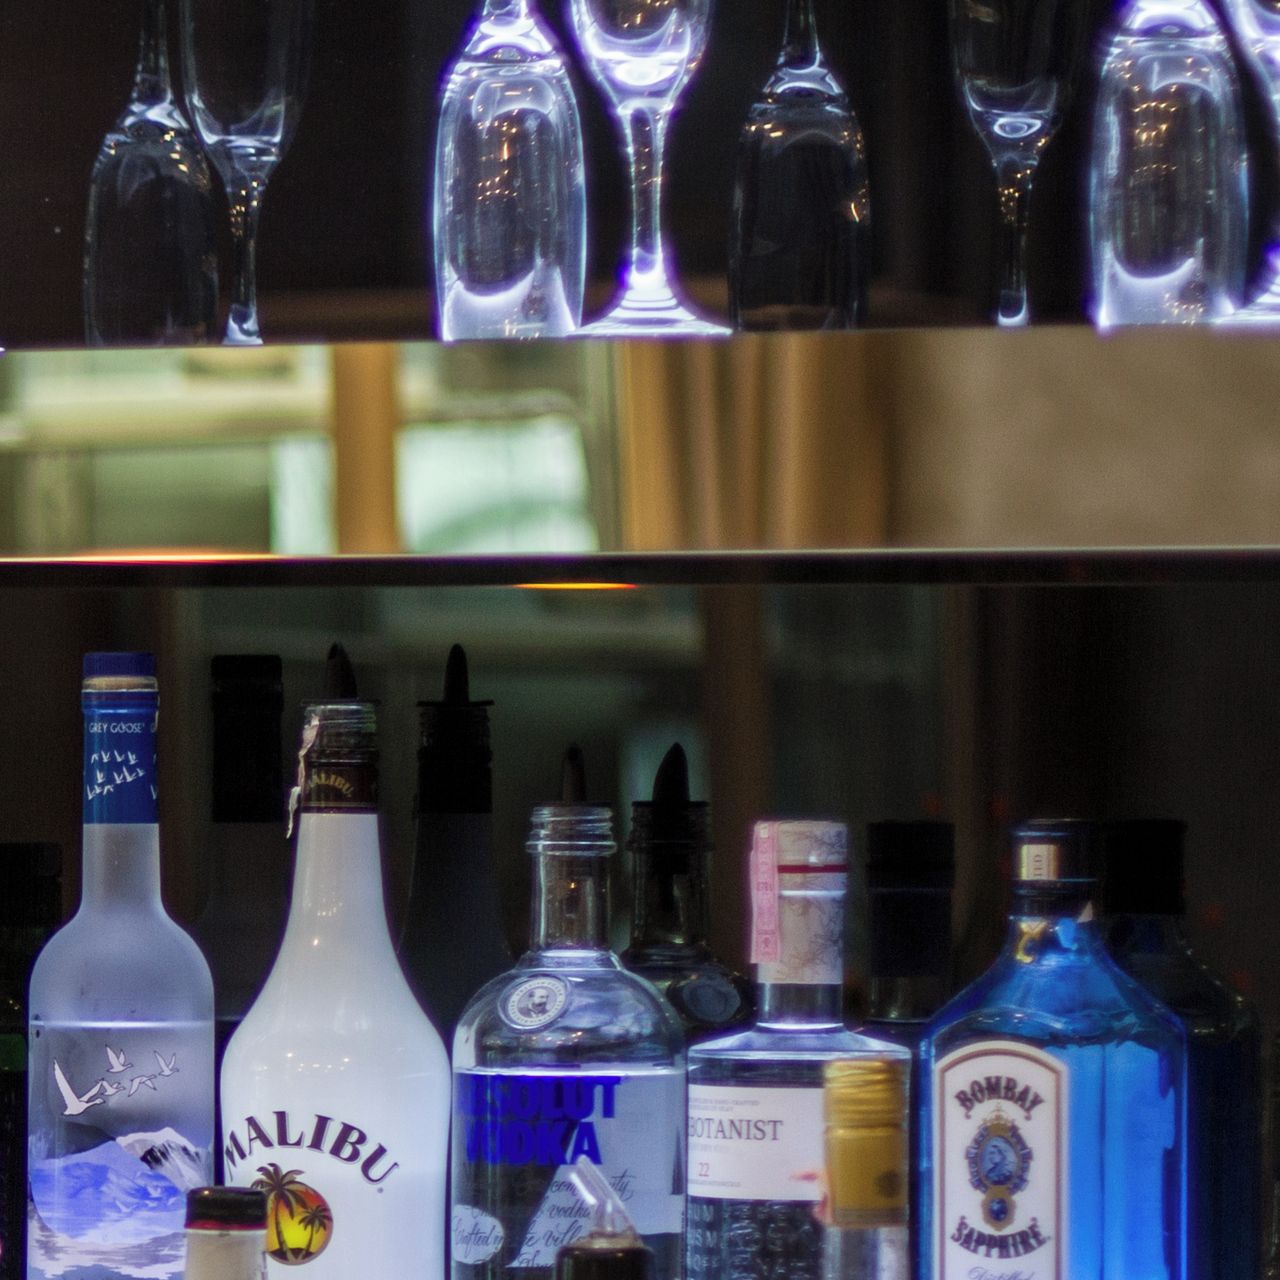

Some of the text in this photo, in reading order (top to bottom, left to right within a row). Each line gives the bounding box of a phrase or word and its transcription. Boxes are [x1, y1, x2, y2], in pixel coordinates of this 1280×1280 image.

[88, 722, 143, 734] GREY GOOSE
[954, 1074, 1045, 1119] BOMBAY
[224, 1110, 400, 1183] MALIBU
[698, 1161, 710, 1178] 22
[951, 1216, 1051, 1260] SAPPHIRE
